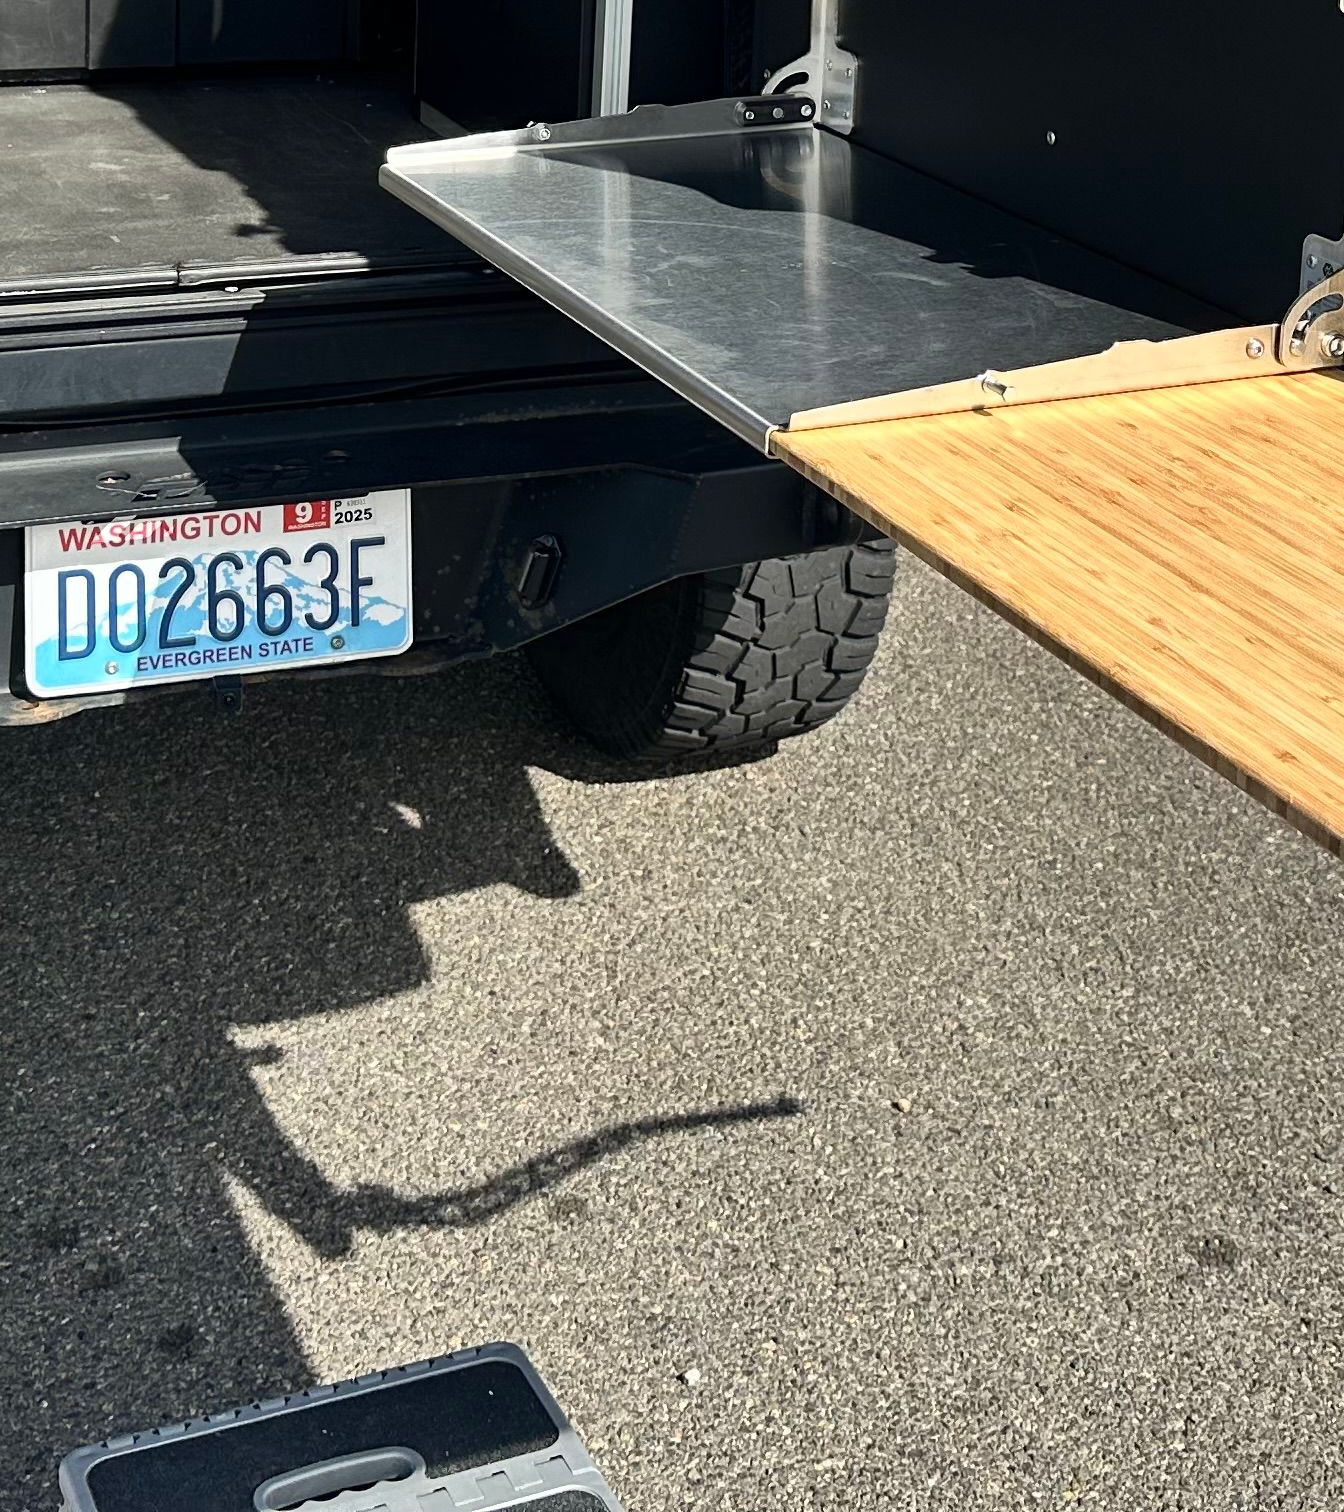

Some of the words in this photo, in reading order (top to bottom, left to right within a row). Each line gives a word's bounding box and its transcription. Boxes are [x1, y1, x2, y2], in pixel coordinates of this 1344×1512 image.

[293, 502, 313, 525] 9
[334, 508, 373, 526] 2025
[58, 510, 262, 552] WASHINGTON
[136, 645, 253, 672] EVERGREEN
[258, 636, 314, 658] STATE
